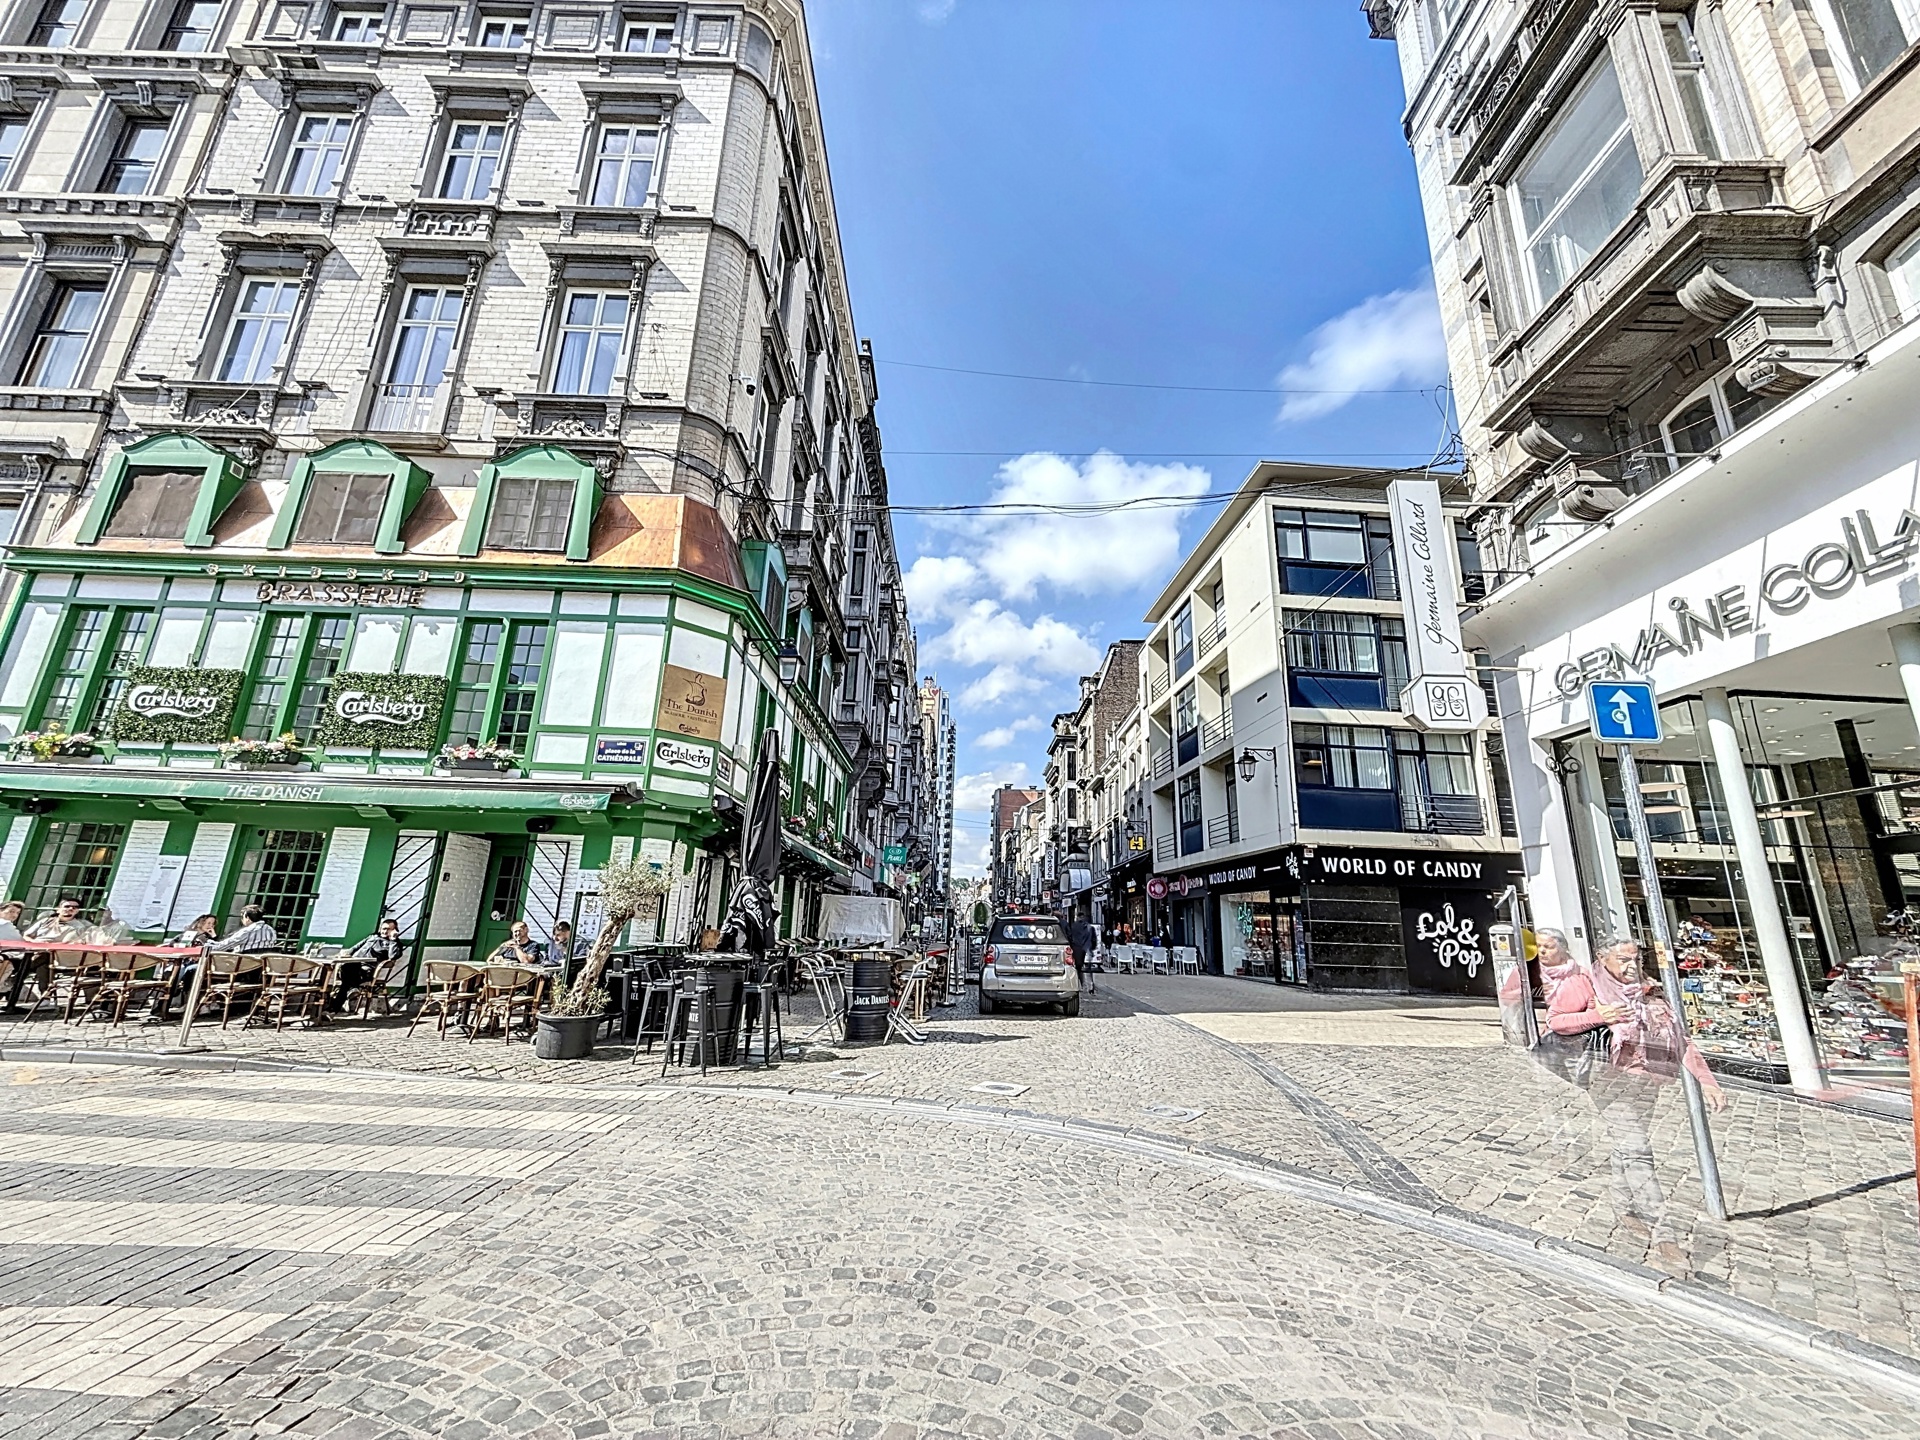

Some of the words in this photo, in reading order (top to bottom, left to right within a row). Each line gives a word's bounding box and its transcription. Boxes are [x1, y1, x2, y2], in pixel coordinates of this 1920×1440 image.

[1405, 498, 1431, 561] Collard
[256, 582, 426, 608] BRASSERIE
[127, 685, 220, 719] Carlsberg
[335, 690, 427, 725] Carlsberg
[666, 698, 683, 711] The
[686, 704, 719, 719] Danish
[596, 753, 643, 763] CATHÉDRALE
[656, 741, 712, 769] Carlsberg
[226, 784, 259, 799] THE
[260, 785, 324, 801] DANISH
[1208, 872, 1227, 885] WORLD
[1227, 870, 1236, 882] OF
[1236, 866, 1257, 880] CANDY
[1321, 856, 1387, 876] WORLD
[1394, 858, 1416, 877] OF
[1423, 860, 1483, 879] CANDY
[1457, 918, 1480, 948] &
[1438, 938, 1483, 978] Pop
[854, 994, 871, 1006] JACK
